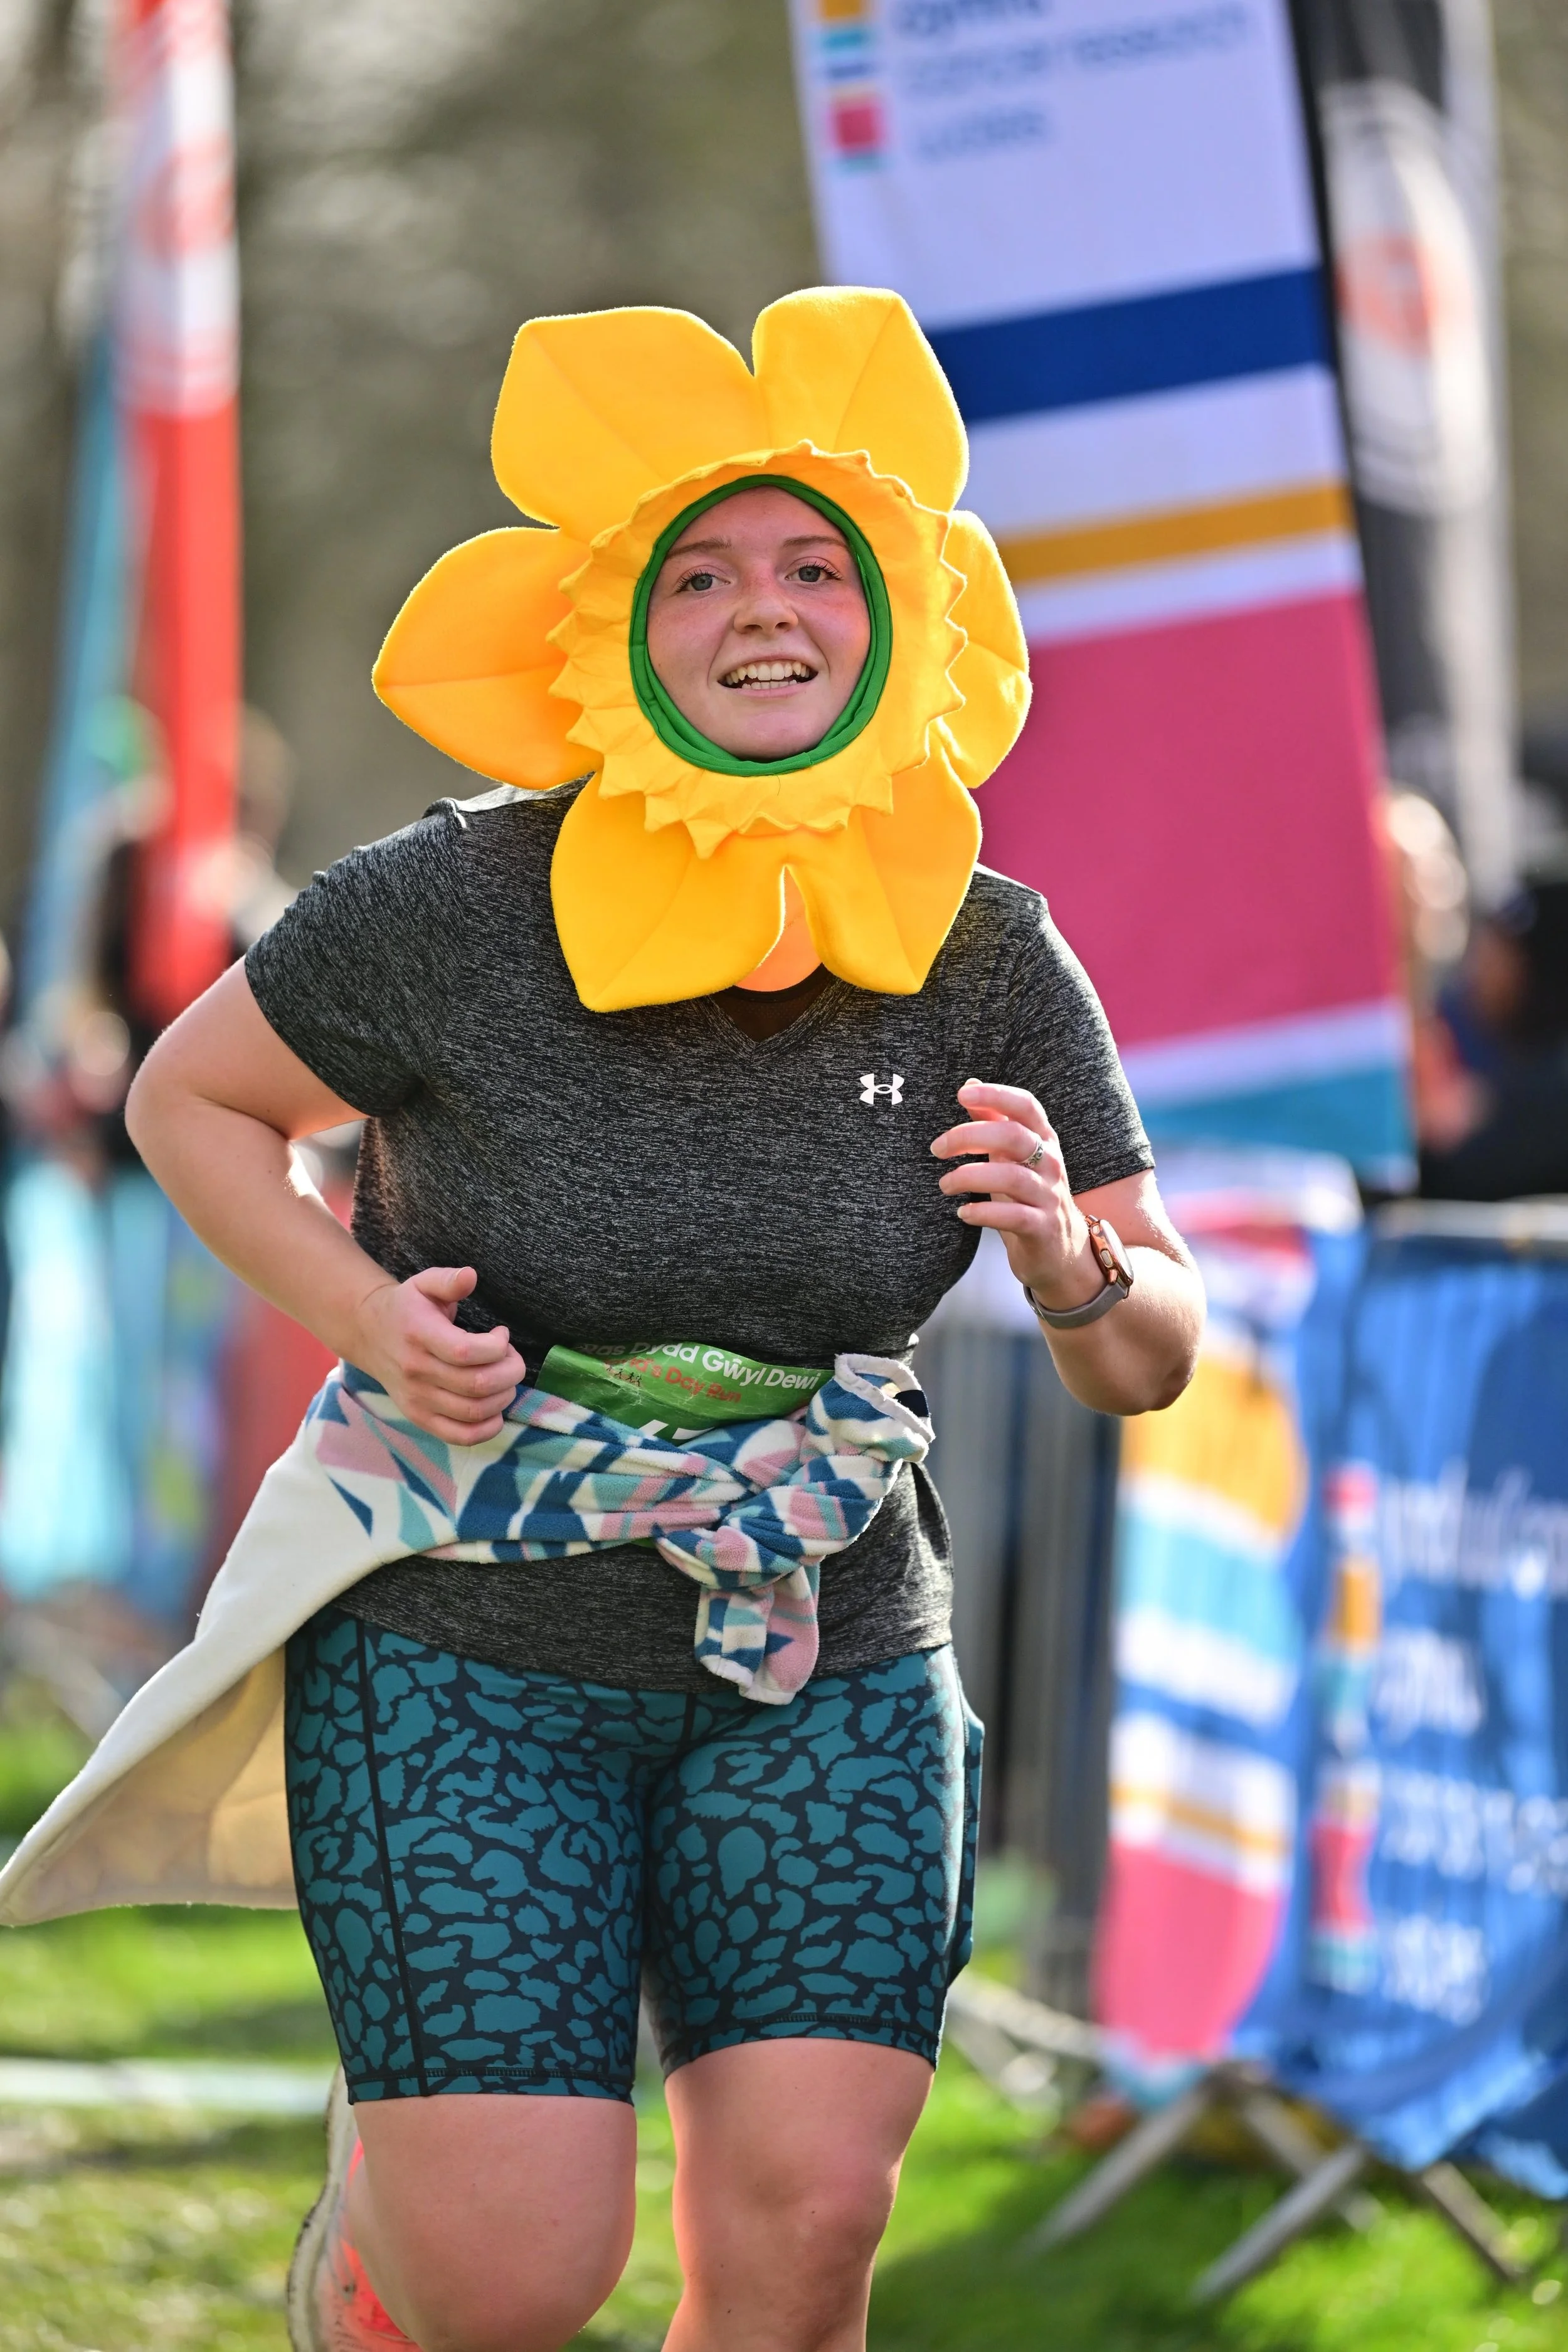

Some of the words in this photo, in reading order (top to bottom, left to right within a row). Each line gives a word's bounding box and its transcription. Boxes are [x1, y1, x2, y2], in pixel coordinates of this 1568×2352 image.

[629, 1342, 700, 1364] Dydd
[702, 1350, 766, 1387] Gŵyl
[764, 1368, 821, 1390] Dewi
[664, 1365, 705, 1396] Day
[706, 1382, 742, 1404] Run
